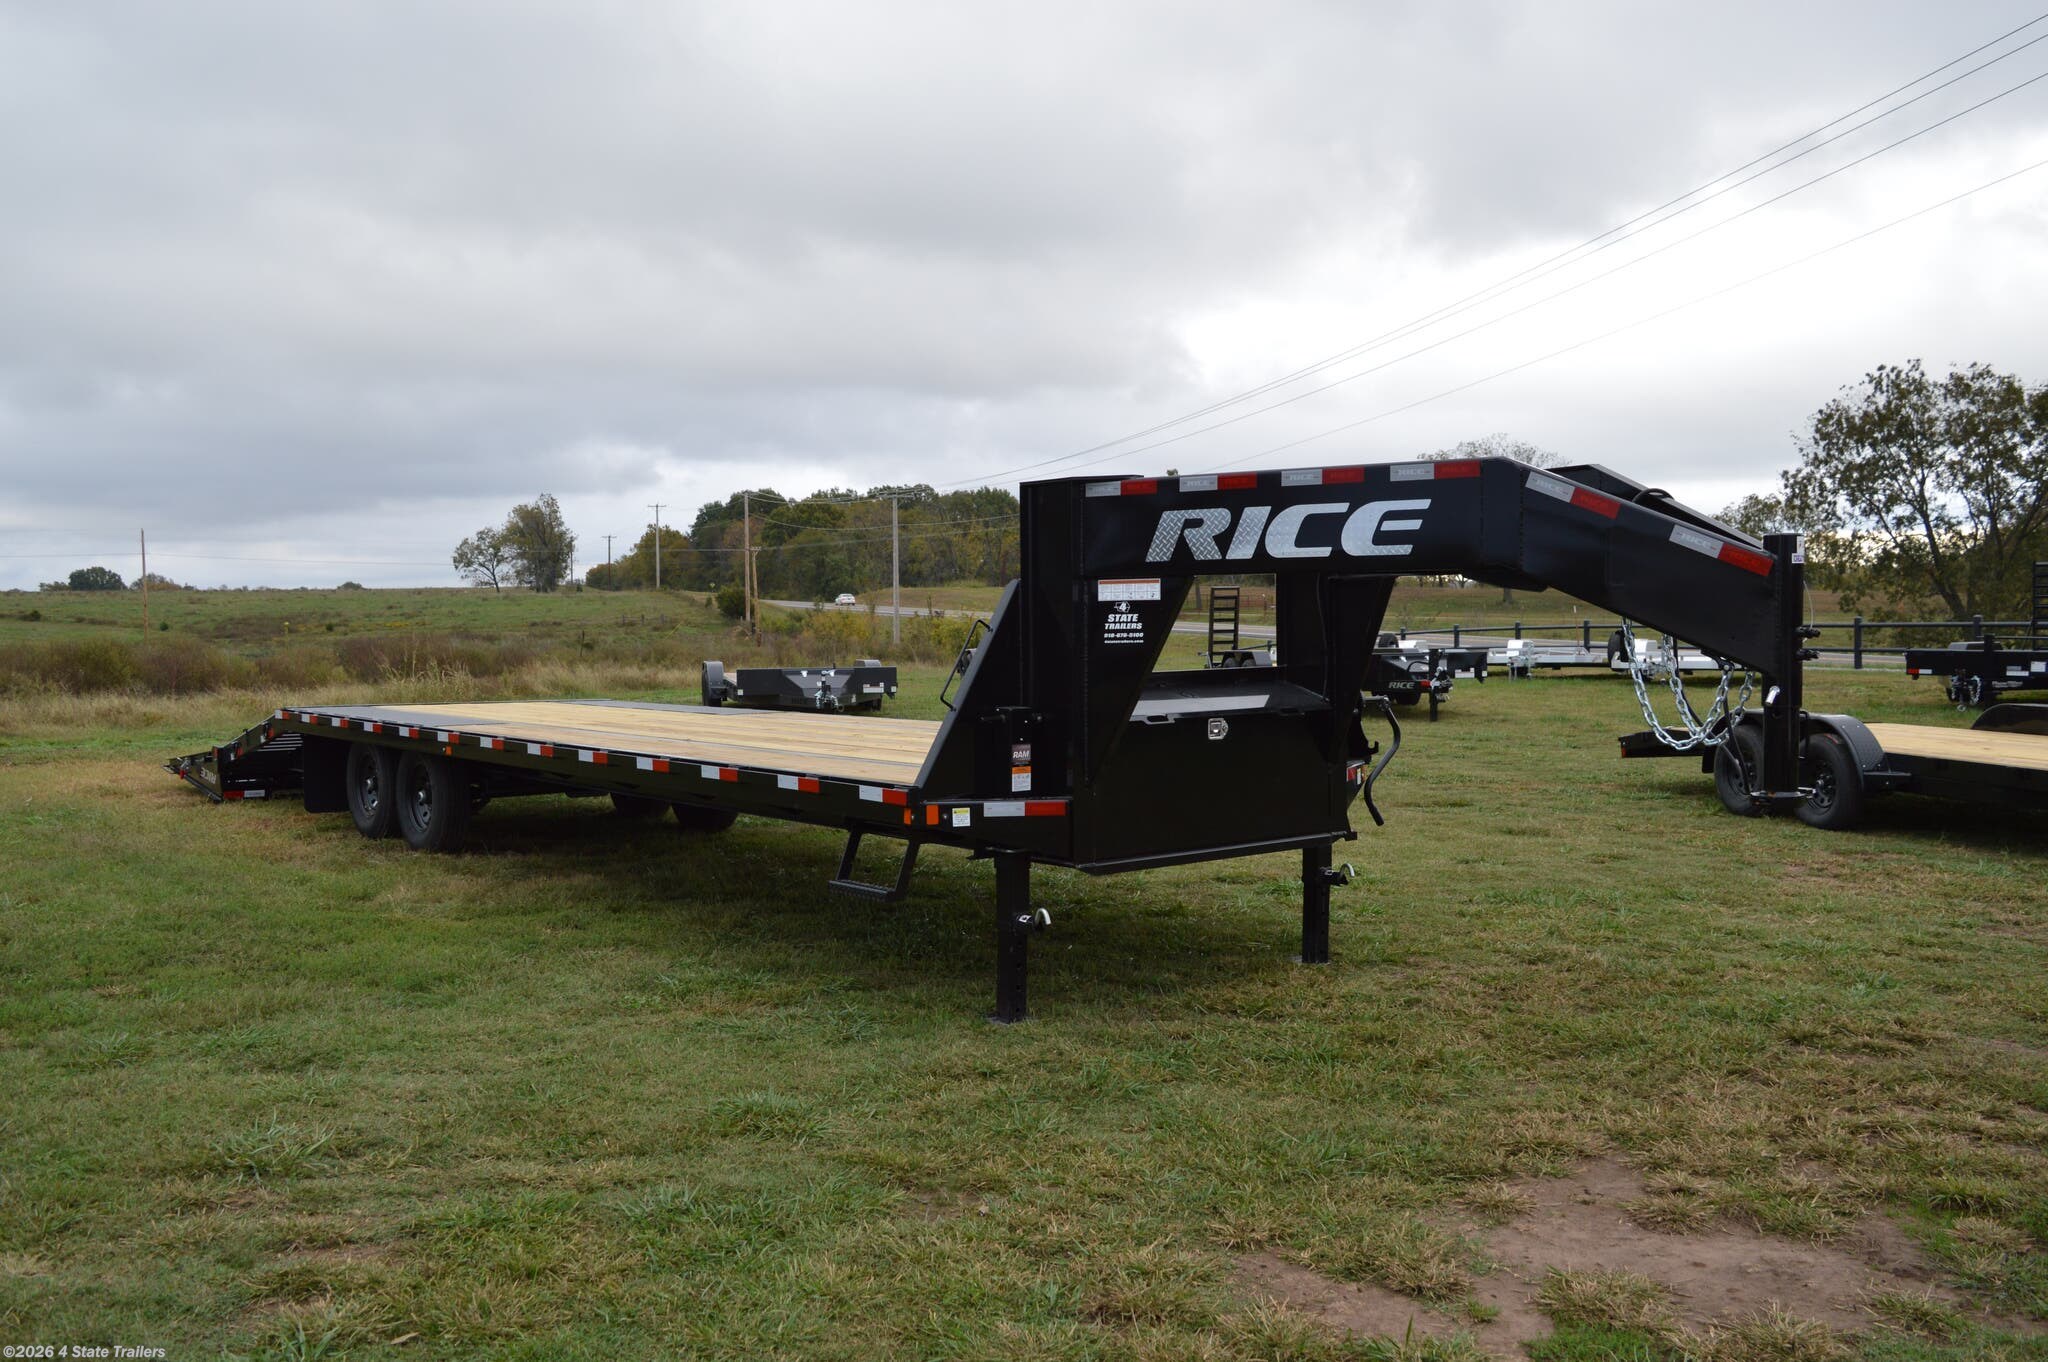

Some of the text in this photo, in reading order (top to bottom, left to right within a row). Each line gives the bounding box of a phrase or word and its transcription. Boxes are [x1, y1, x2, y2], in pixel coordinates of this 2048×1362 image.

[1145, 499, 1432, 563] RICE
[1107, 614, 1139, 622] STATE
[1388, 681, 1416, 689] RICE
[1012, 751, 1030, 759] RAM
